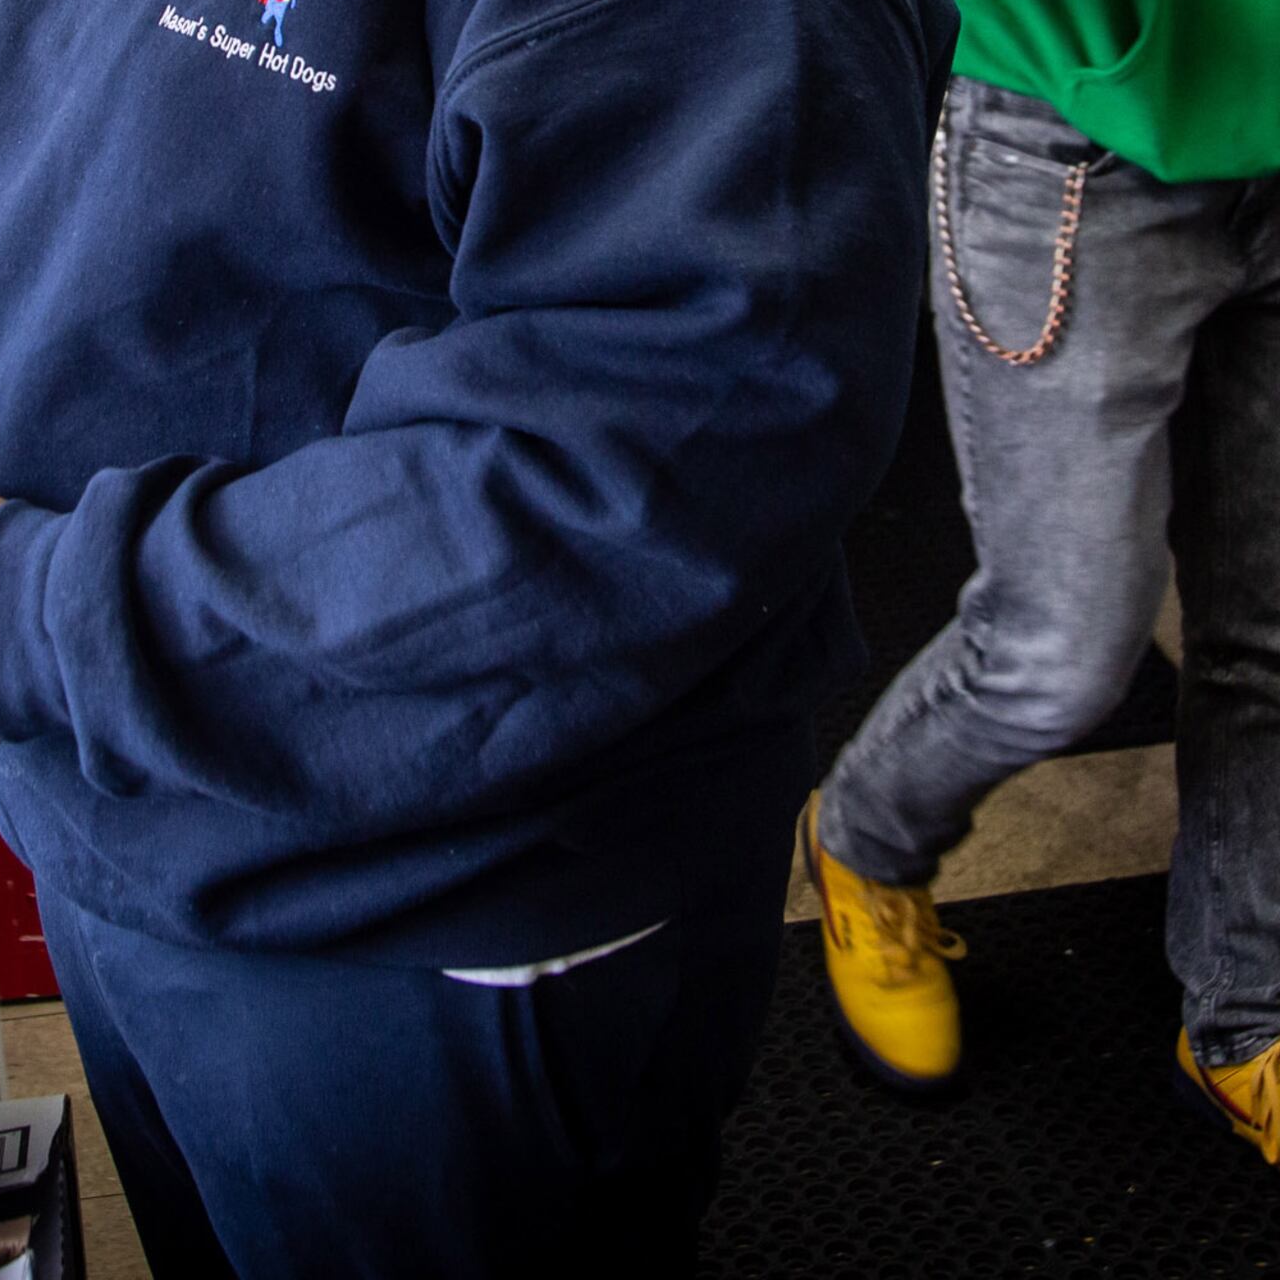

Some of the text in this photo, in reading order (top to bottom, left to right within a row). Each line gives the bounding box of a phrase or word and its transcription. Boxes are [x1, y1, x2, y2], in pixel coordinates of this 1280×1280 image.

[158, 4, 337, 92] Mason's Super Hot Dogs
